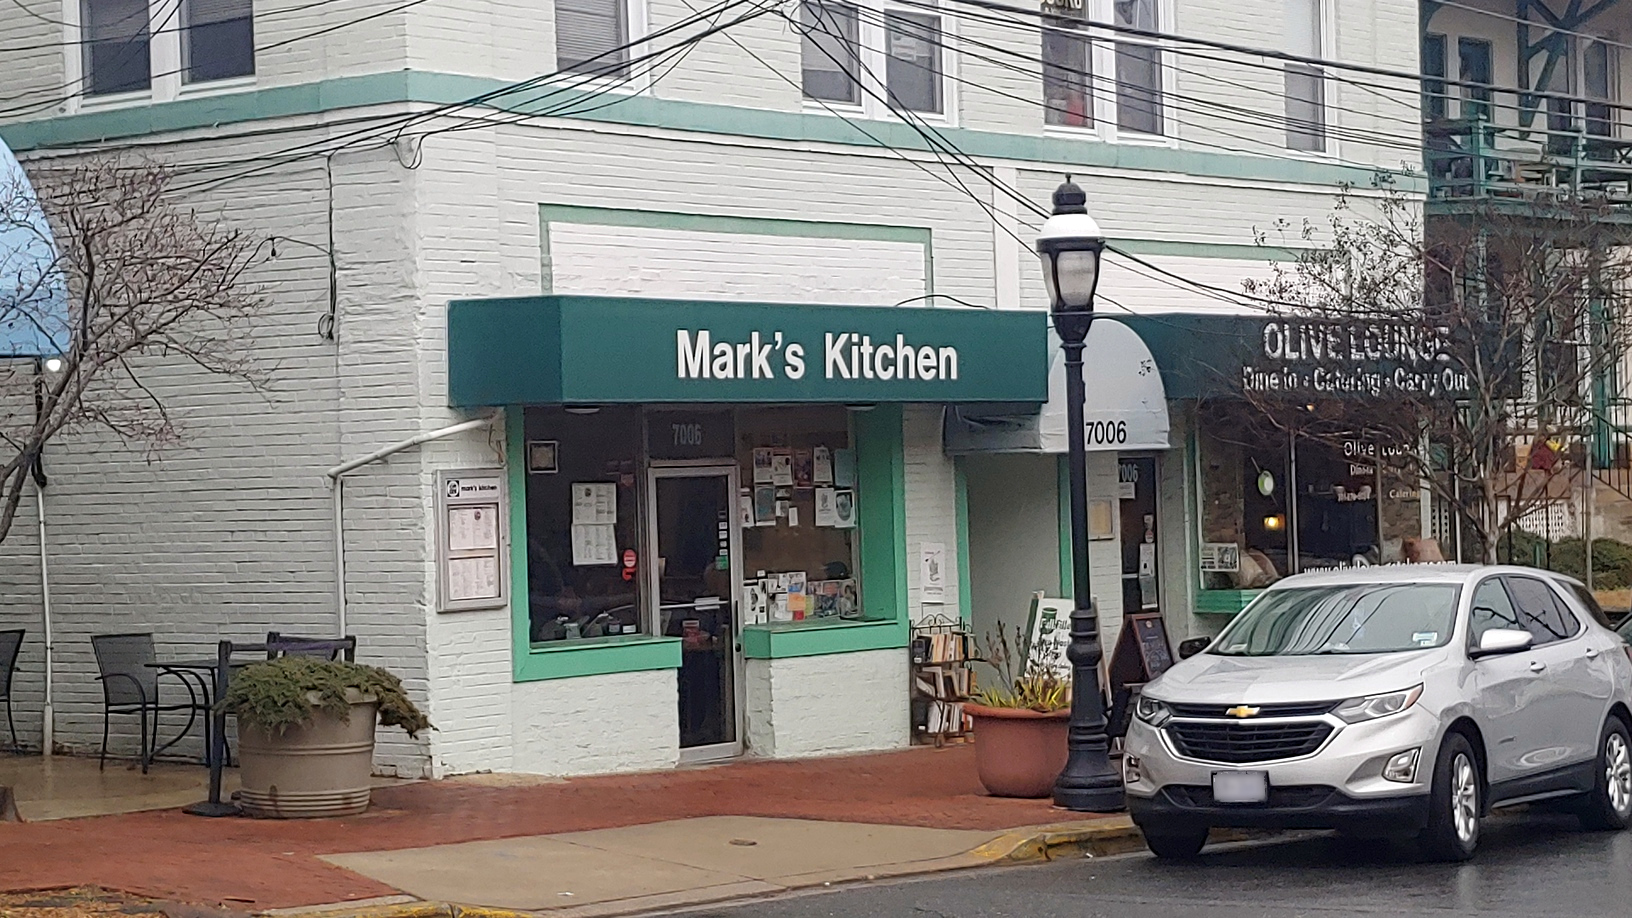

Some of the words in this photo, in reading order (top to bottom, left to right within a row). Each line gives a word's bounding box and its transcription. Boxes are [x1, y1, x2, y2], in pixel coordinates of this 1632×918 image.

[677, 329, 805, 379] Mark's
[824, 332, 958, 380] Kitchen
[1263, 322, 1343, 360] OLIVE
[1350, 324, 1450, 362] LOUNGE
[1243, 366, 1279, 391] Dine
[1314, 367, 1381, 396] Catering
[1395, 367, 1438, 396] Carry
[1442, 367, 1470, 391] Out
[672, 423, 702, 446] 7006
[1085, 420, 1127, 445] 7006
[1343, 440, 1375, 456] Olive
